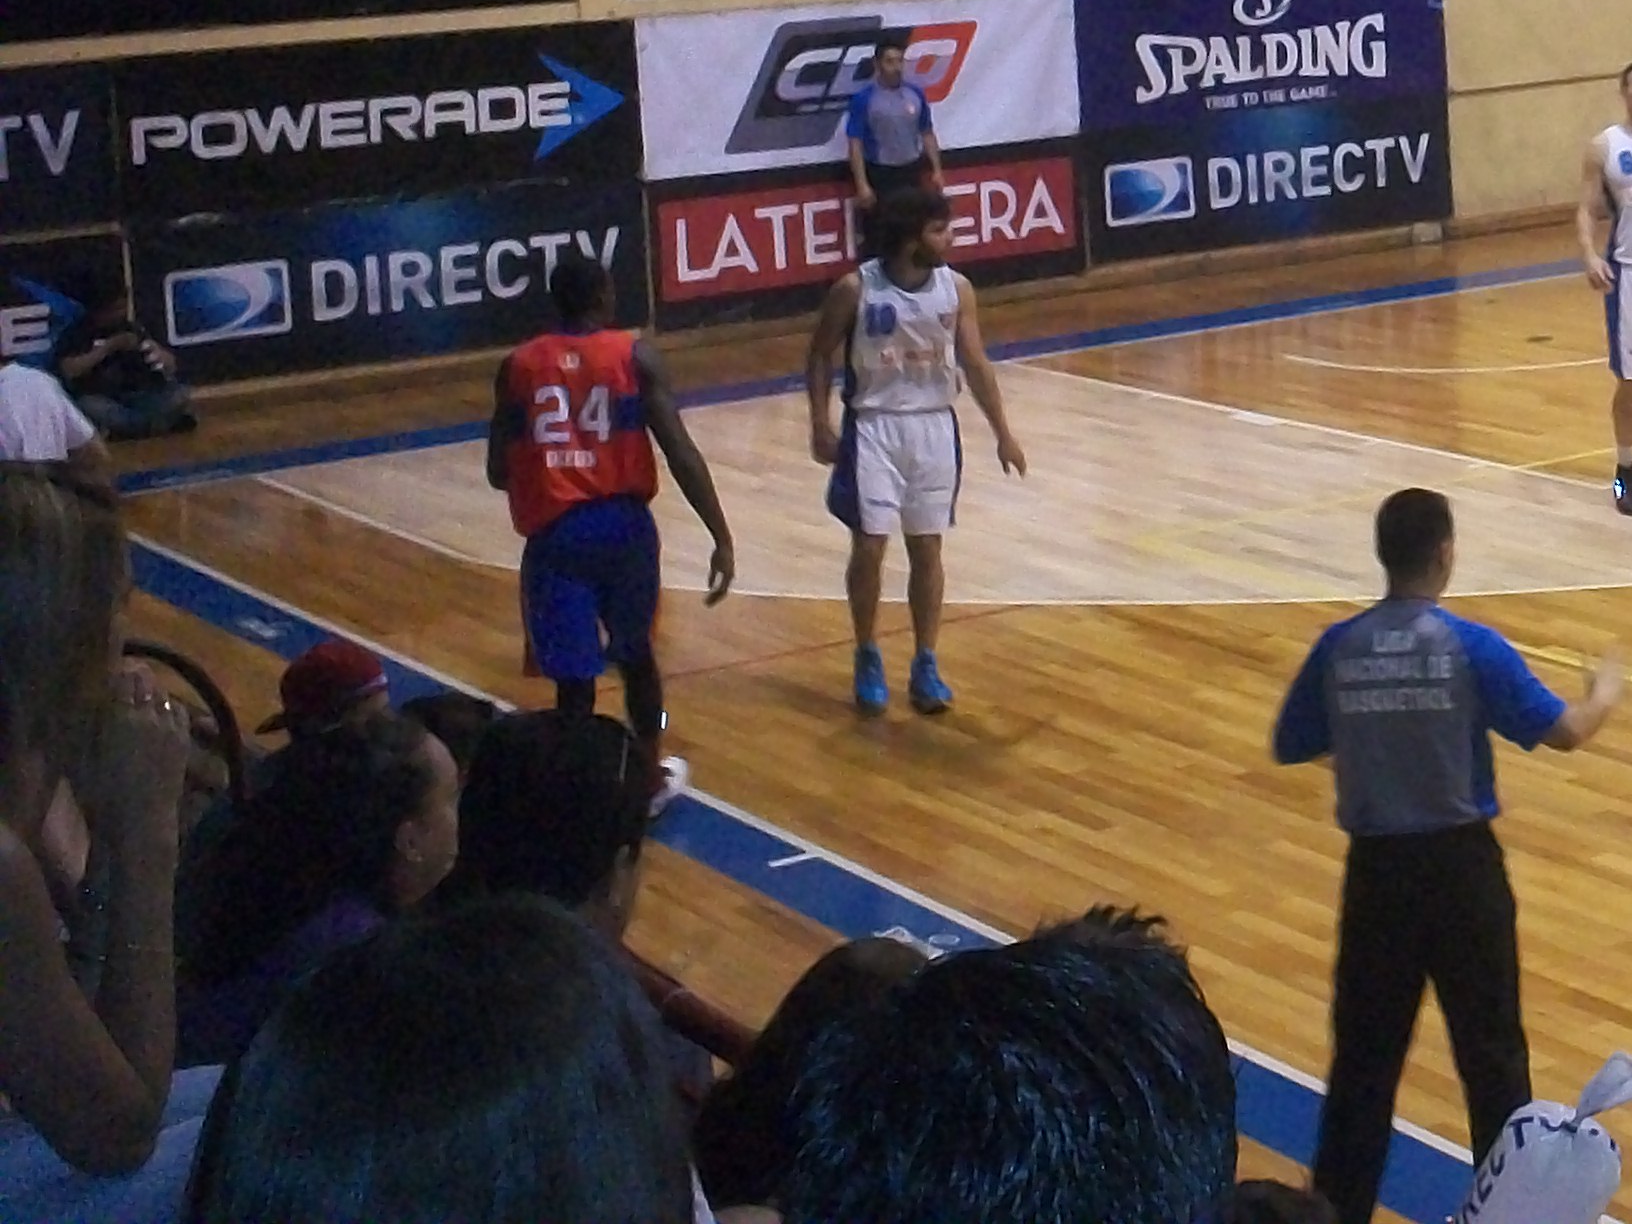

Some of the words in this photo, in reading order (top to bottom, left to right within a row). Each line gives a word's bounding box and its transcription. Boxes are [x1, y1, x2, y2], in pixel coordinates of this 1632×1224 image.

[1135, 13, 1387, 104] SPALDING
[130, 80, 572, 166] POWERADE
[1207, 132, 1430, 210] DIRECTV
[675, 176, 1066, 283] LATEERA
[311, 226, 620, 323] DIRECTV
[533, 385, 612, 444] 24
